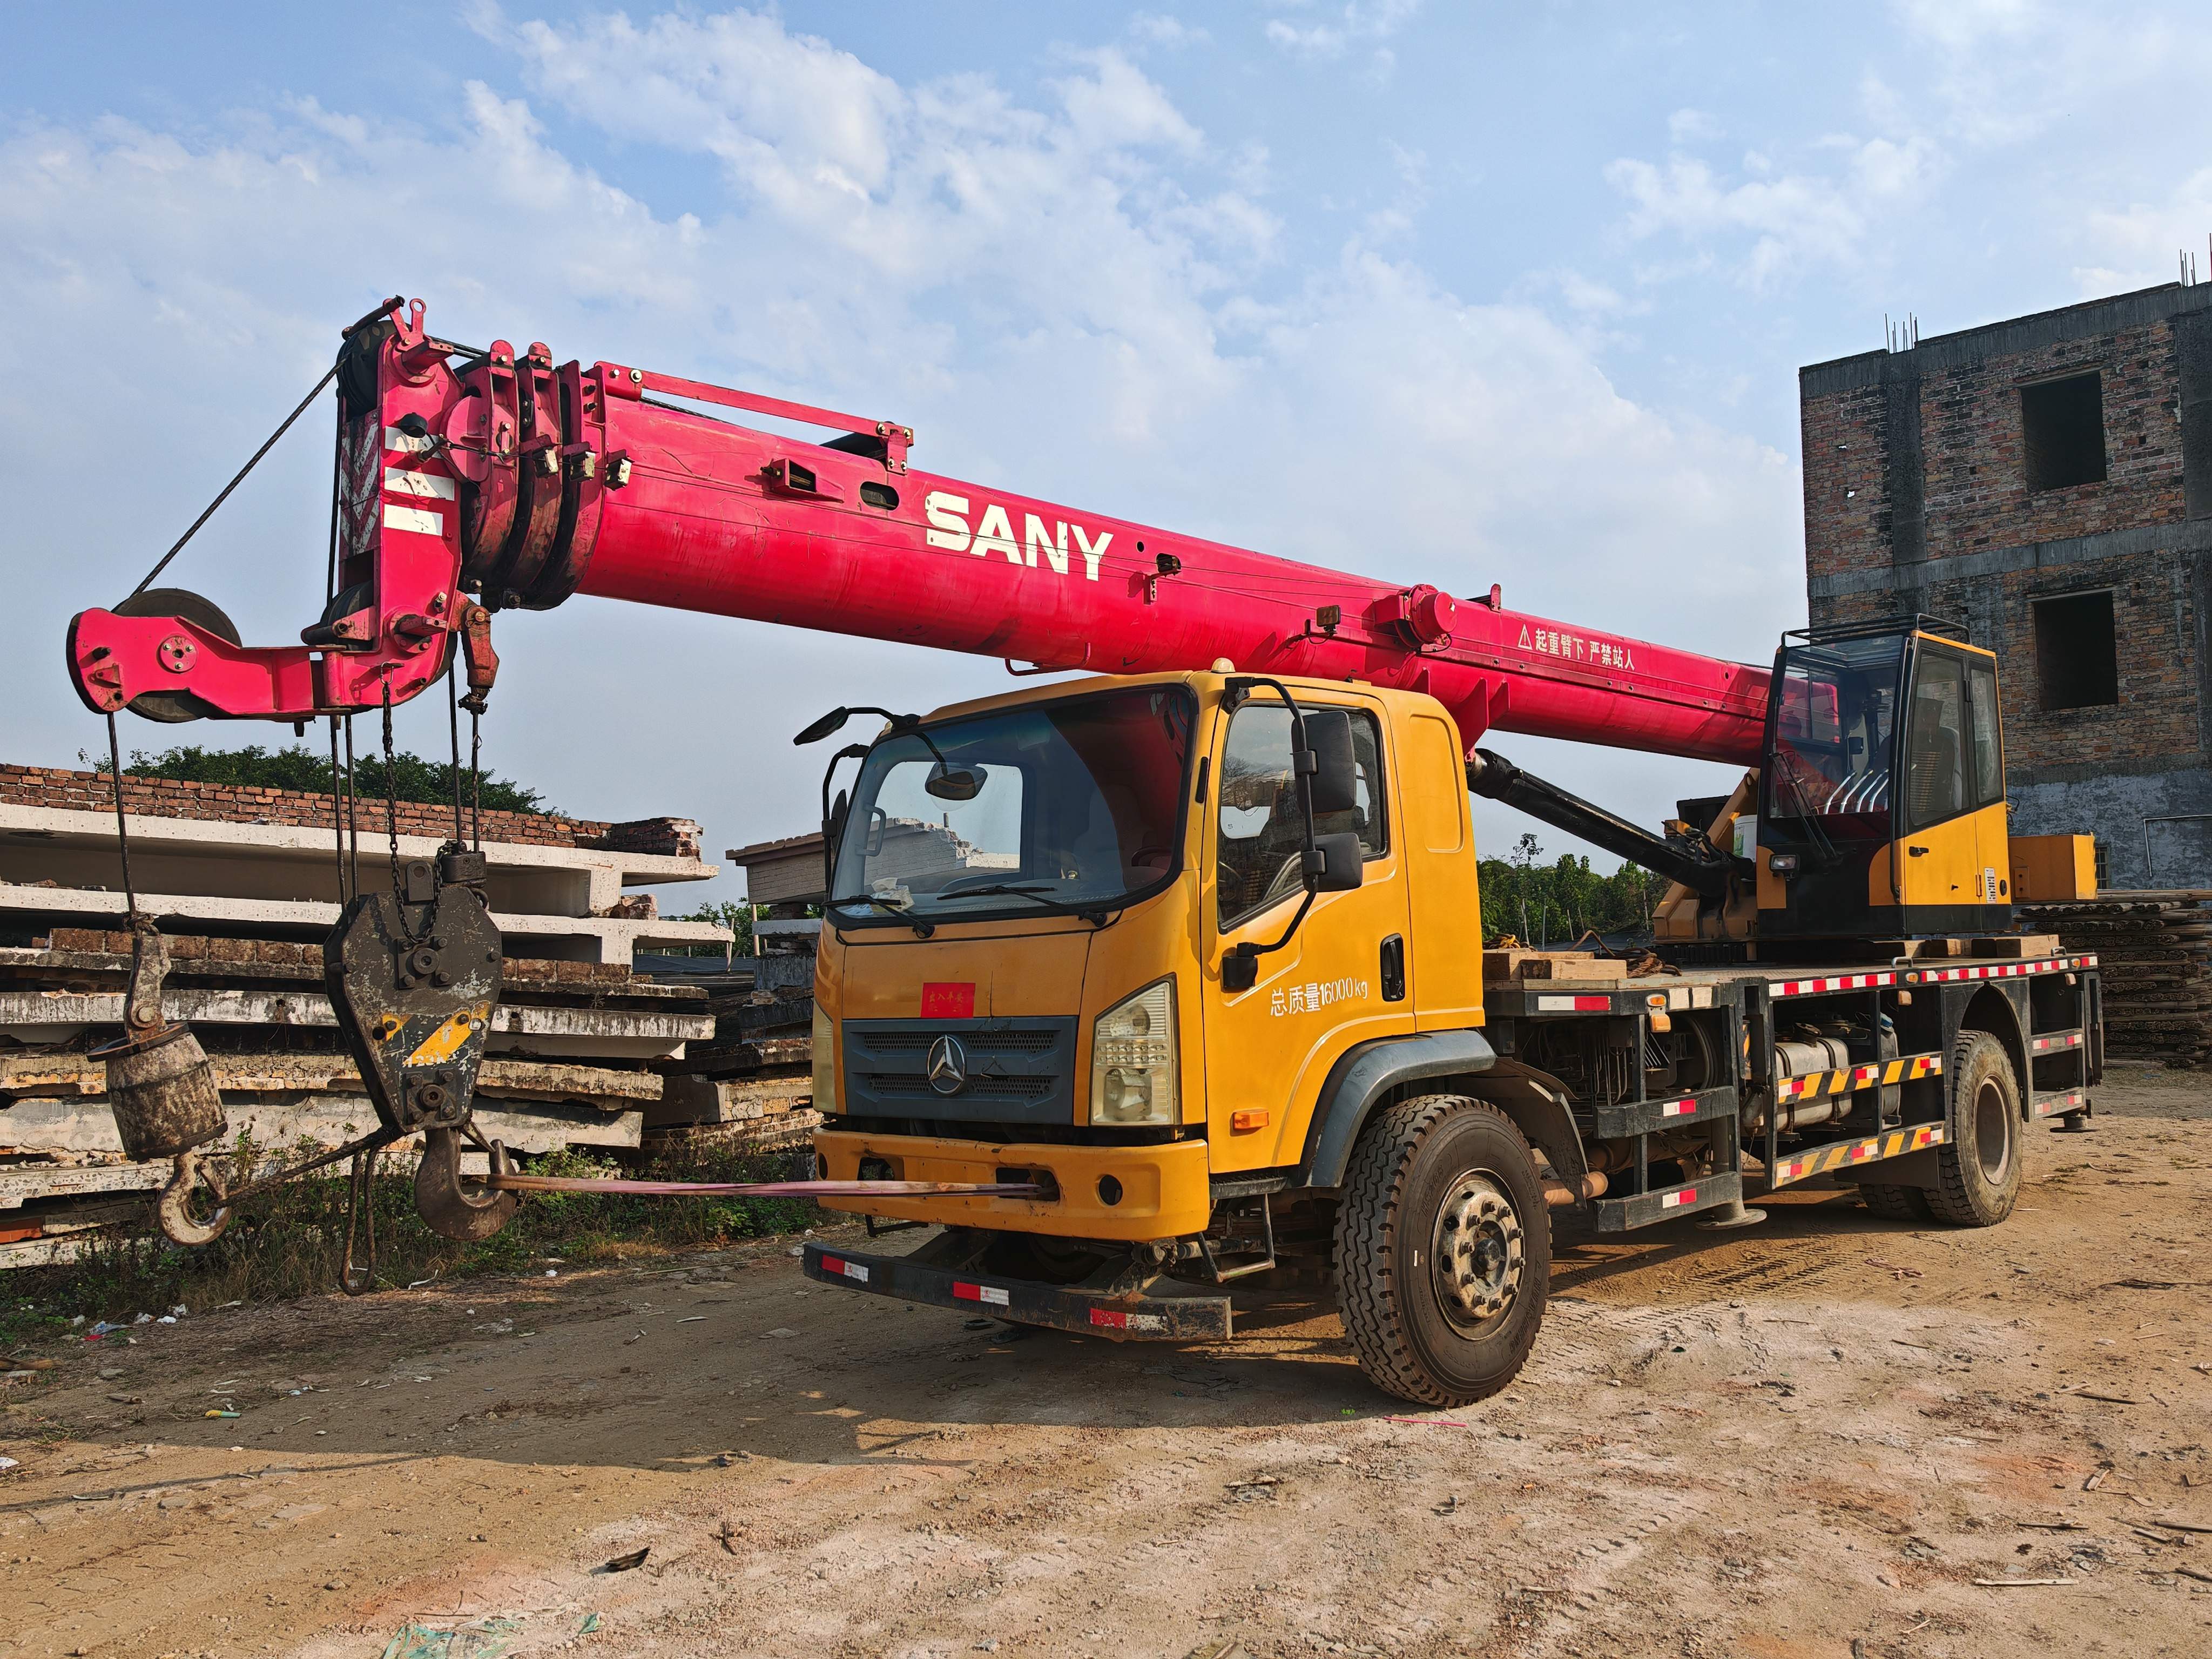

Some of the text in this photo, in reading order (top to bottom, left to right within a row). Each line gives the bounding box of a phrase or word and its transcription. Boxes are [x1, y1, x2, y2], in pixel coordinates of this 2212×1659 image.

[925, 491, 1114, 581] SANY
[1535, 628, 1635, 671] 起重臂下 严禁站人
